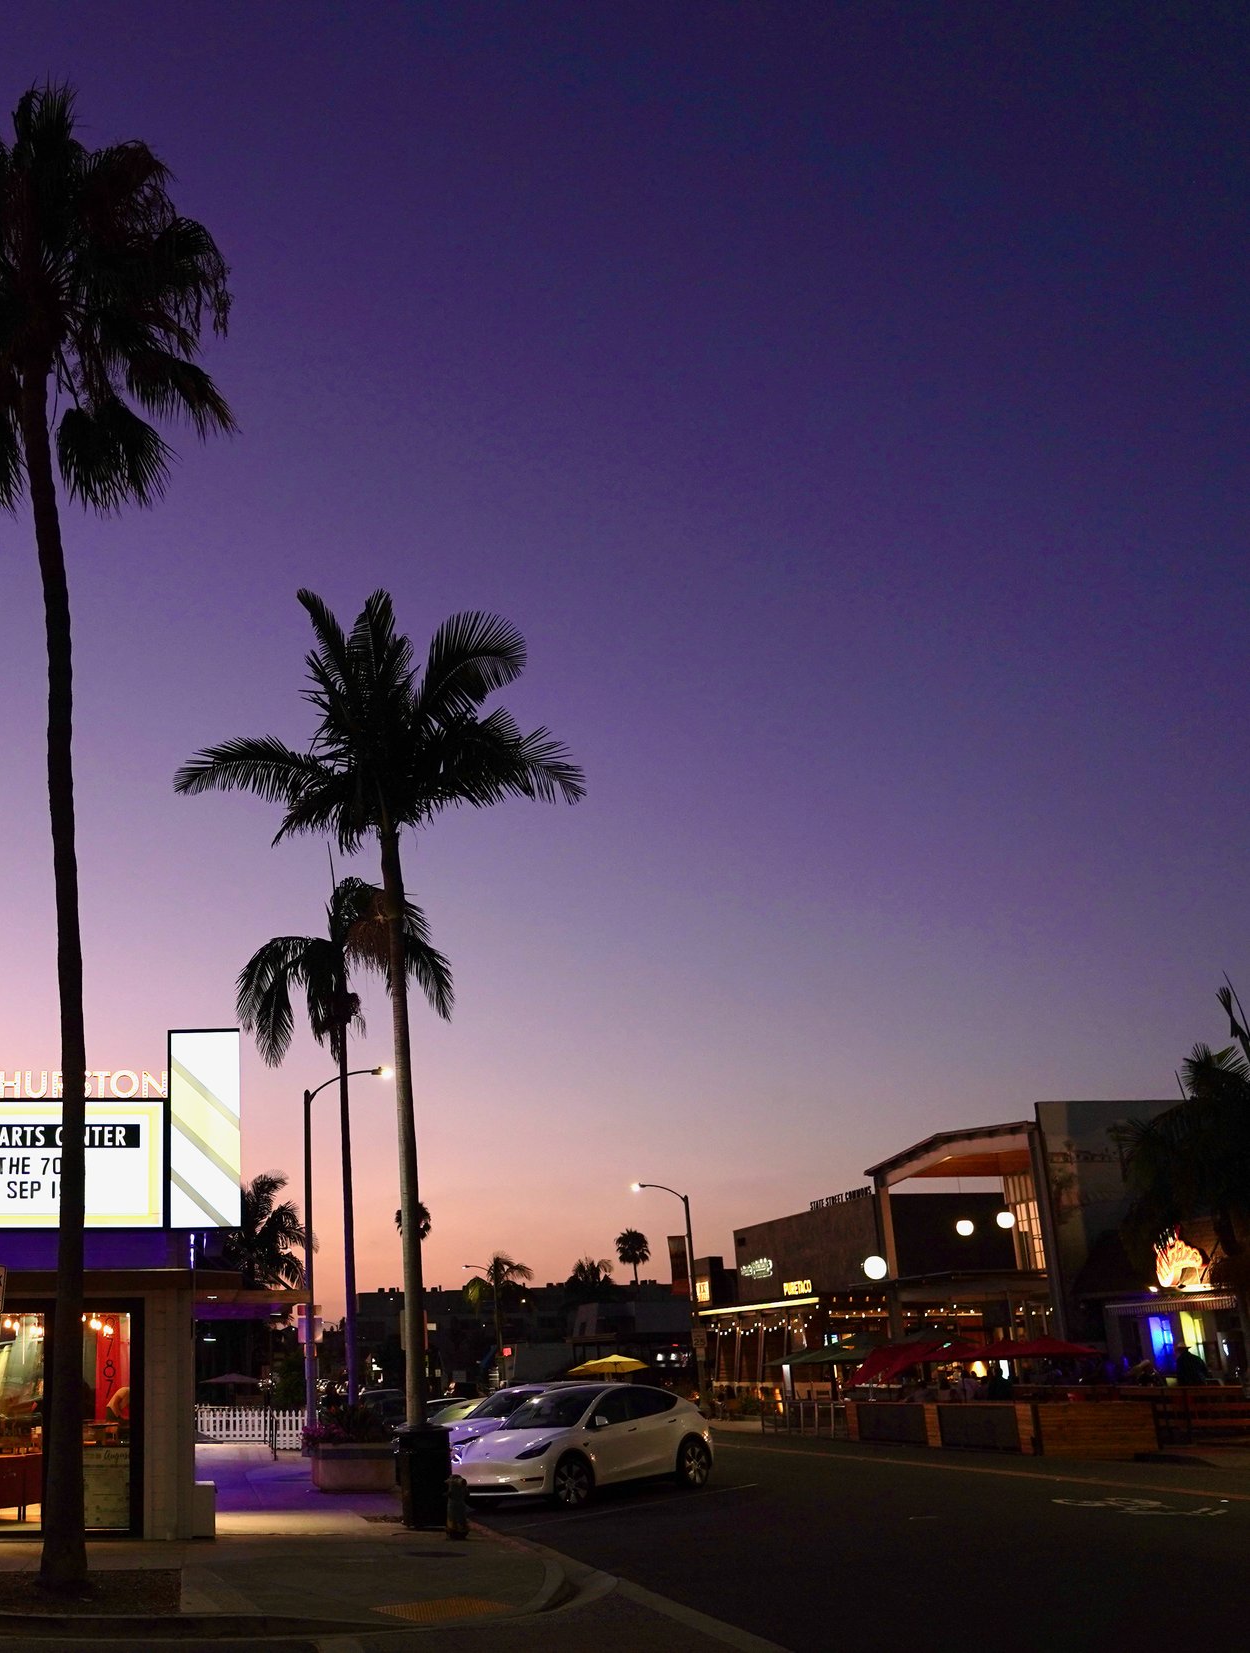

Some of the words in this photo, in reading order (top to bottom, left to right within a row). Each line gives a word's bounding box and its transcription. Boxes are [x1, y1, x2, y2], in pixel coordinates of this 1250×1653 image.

[7, 1181, 41, 1199] SEP
[810, 1199, 824, 1210] STATE
[825, 1193, 844, 1206] STREET
